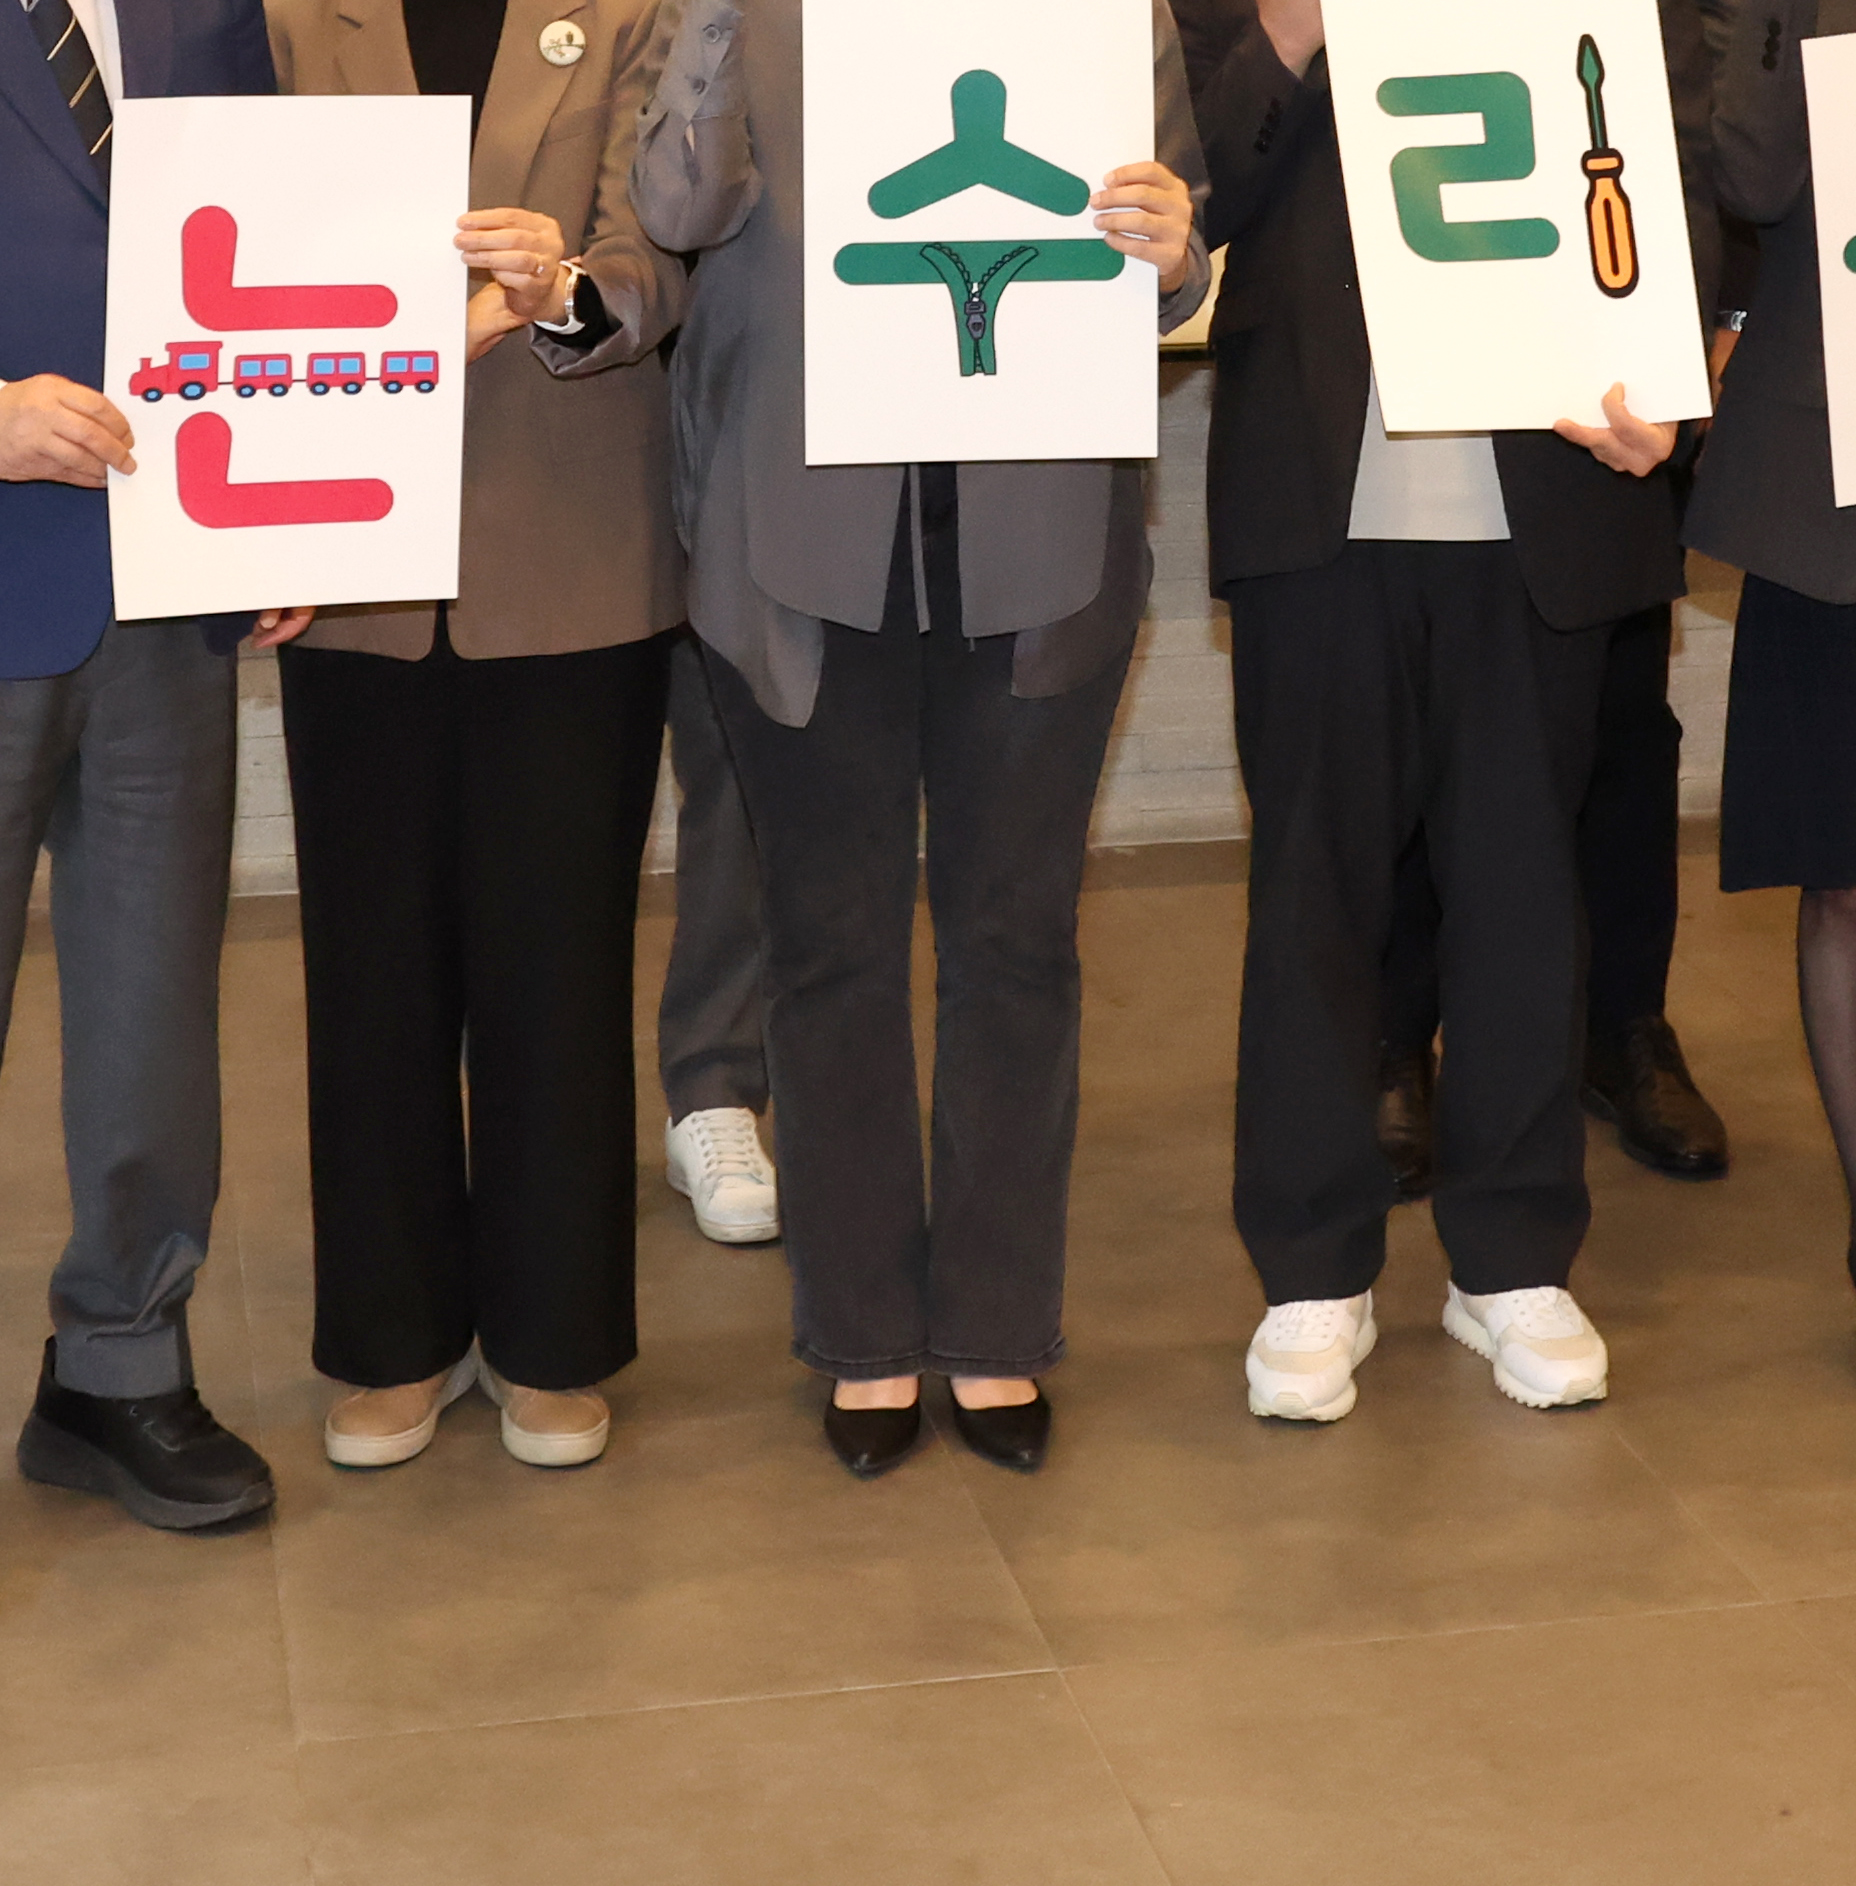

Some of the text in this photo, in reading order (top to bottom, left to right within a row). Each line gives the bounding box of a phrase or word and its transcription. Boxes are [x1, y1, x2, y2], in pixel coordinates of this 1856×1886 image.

[833, 69, 1126, 377] 수
[1375, 33, 1640, 300] 리
[128, 204, 440, 530] 는
